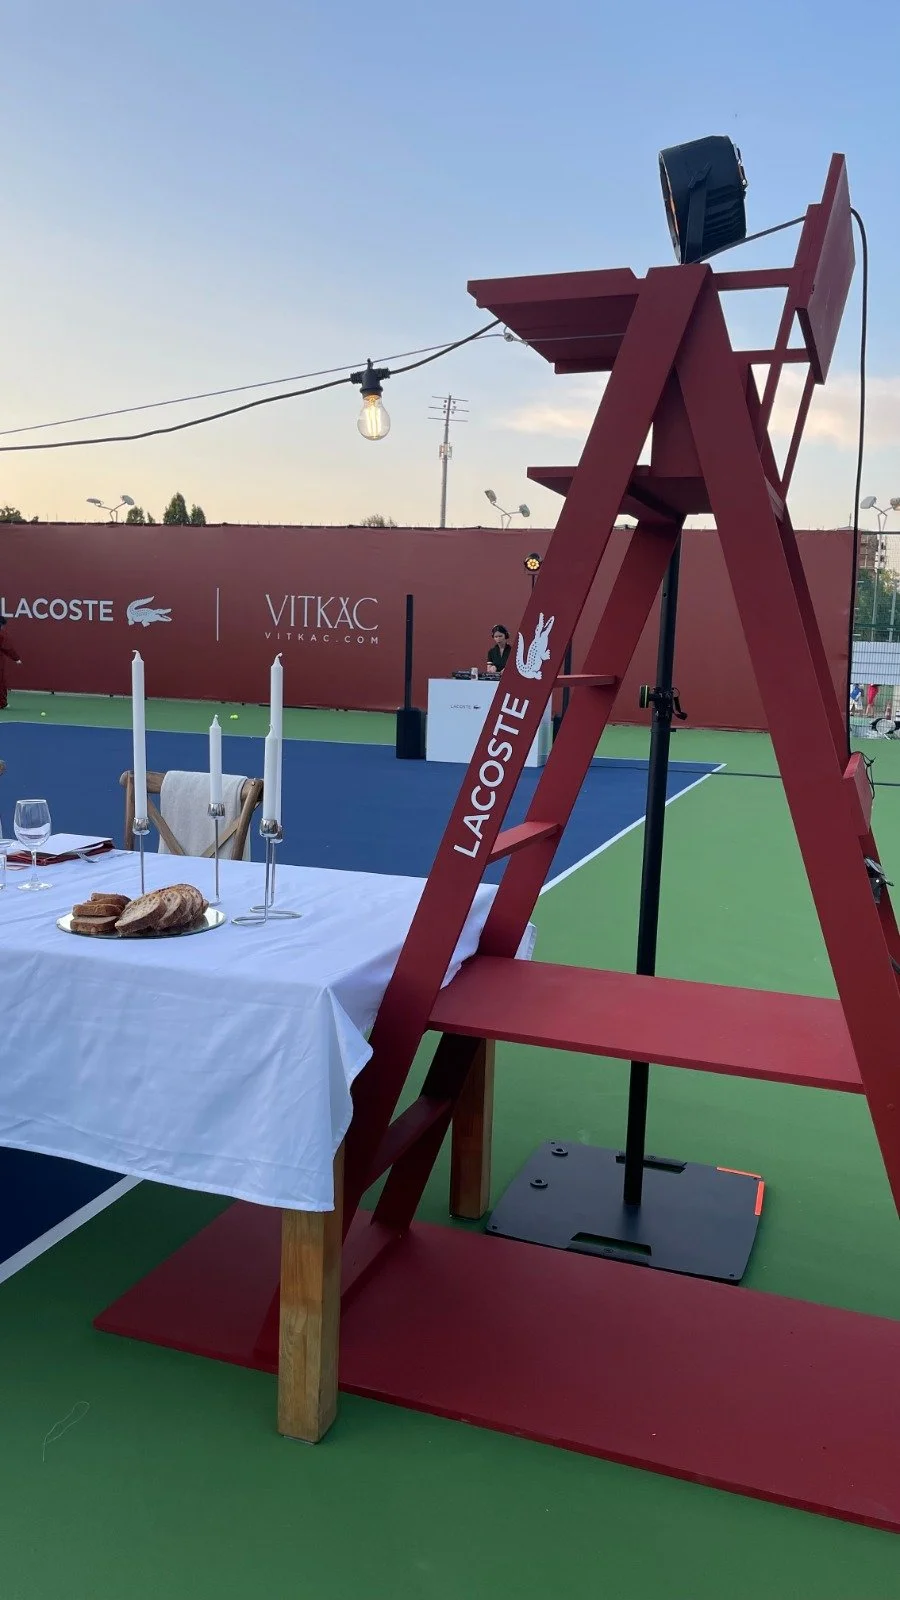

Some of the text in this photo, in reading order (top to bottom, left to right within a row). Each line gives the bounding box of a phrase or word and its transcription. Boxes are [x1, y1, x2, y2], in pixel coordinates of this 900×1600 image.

[1, 597, 114, 621] LACOSTE
[265, 594, 379, 631] VITKAC
[264, 632, 379, 644] VITKAC.COM
[453, 692, 530, 858] LACOSTE
